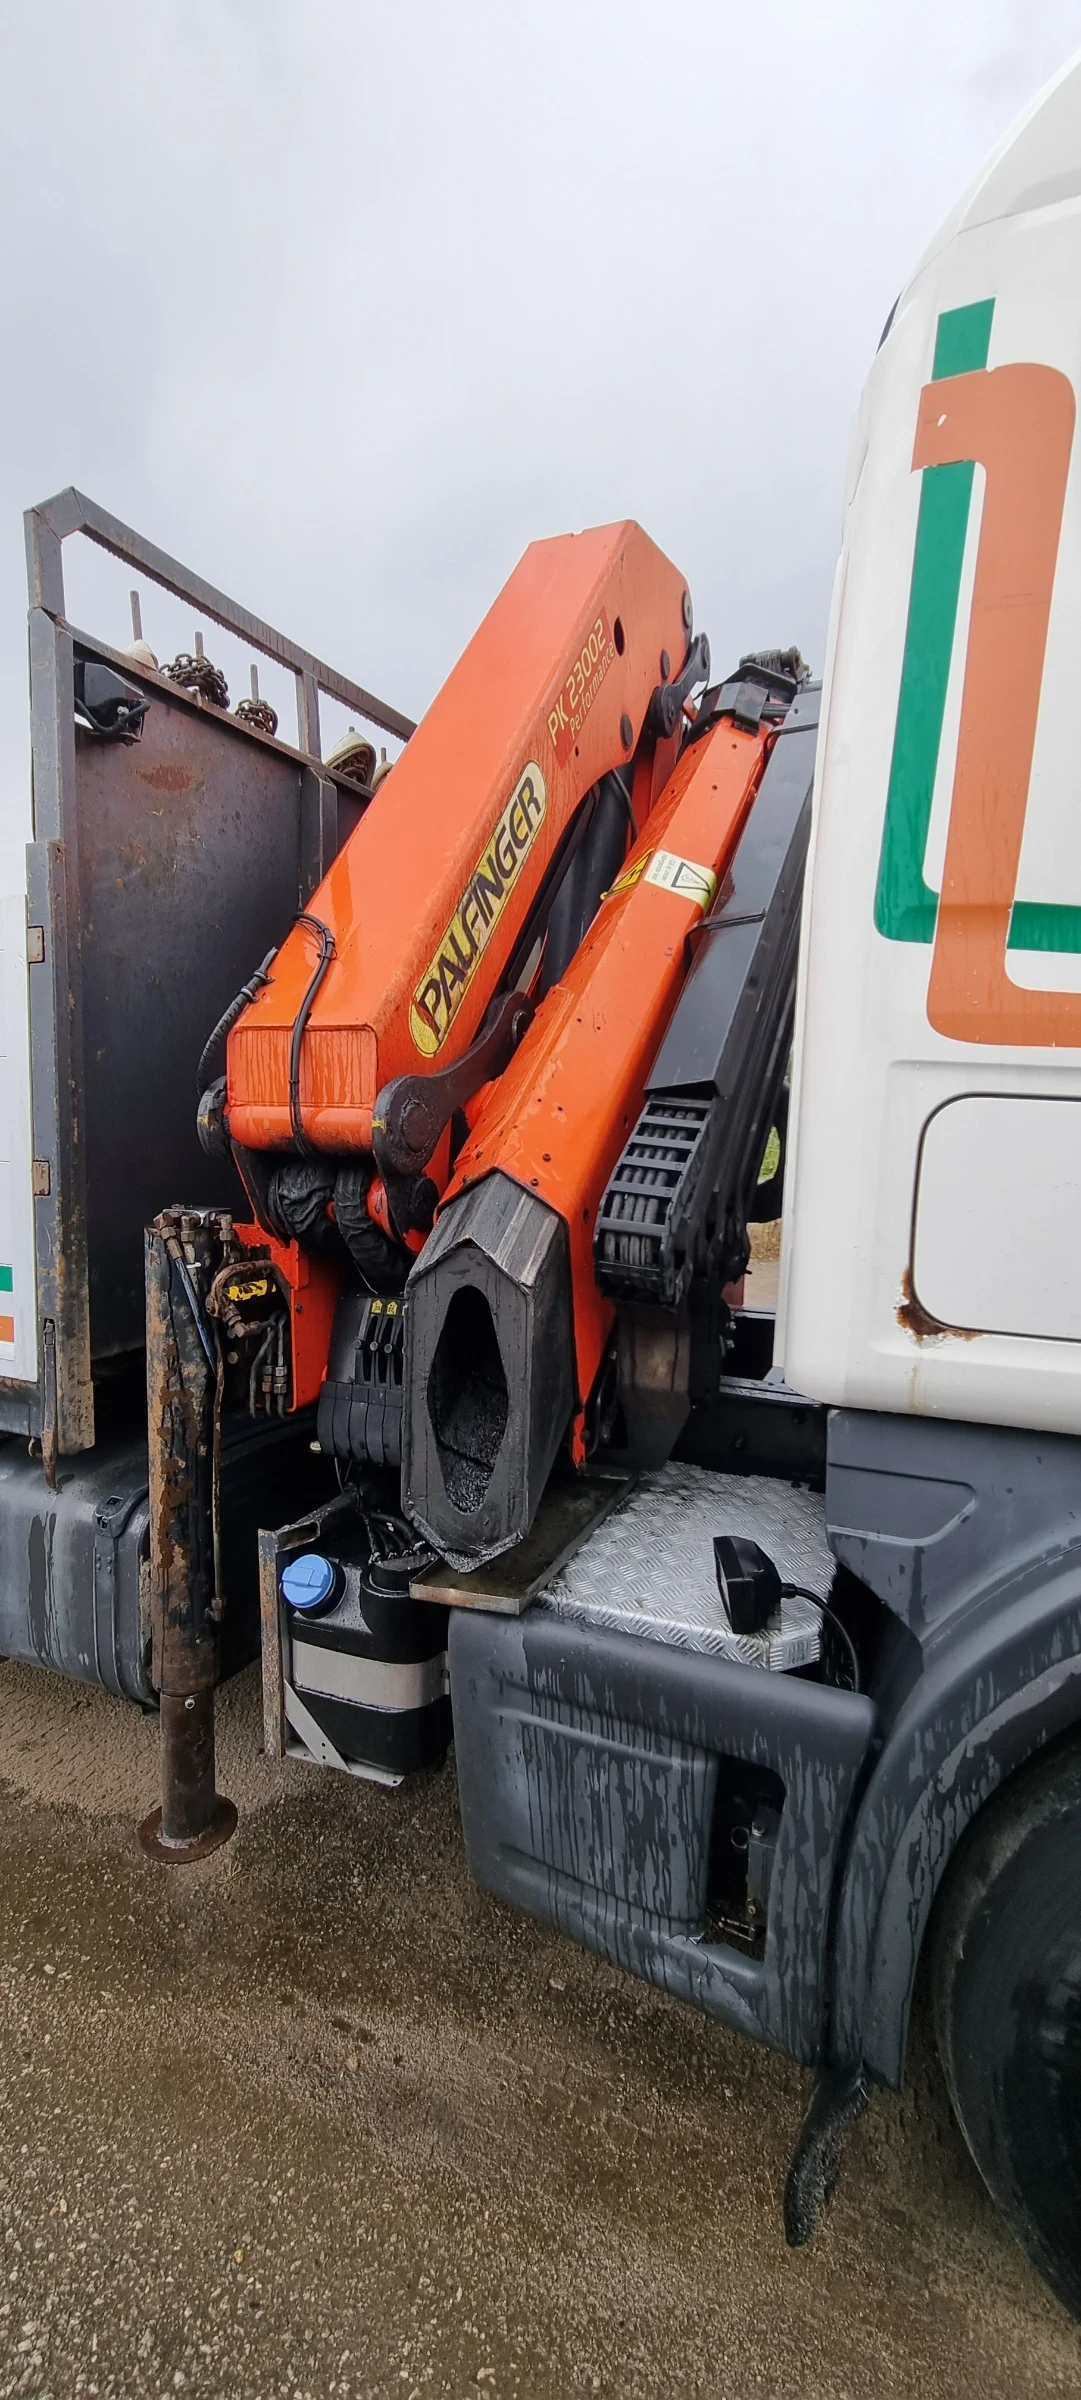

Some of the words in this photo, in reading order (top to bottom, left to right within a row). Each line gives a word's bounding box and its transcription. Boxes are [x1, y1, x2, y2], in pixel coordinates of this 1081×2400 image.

[547, 693, 569, 747] PK
[566, 618, 606, 709] 23002
[569, 641, 615, 740] Performance
[418, 776, 542, 1042] PALFINGER
